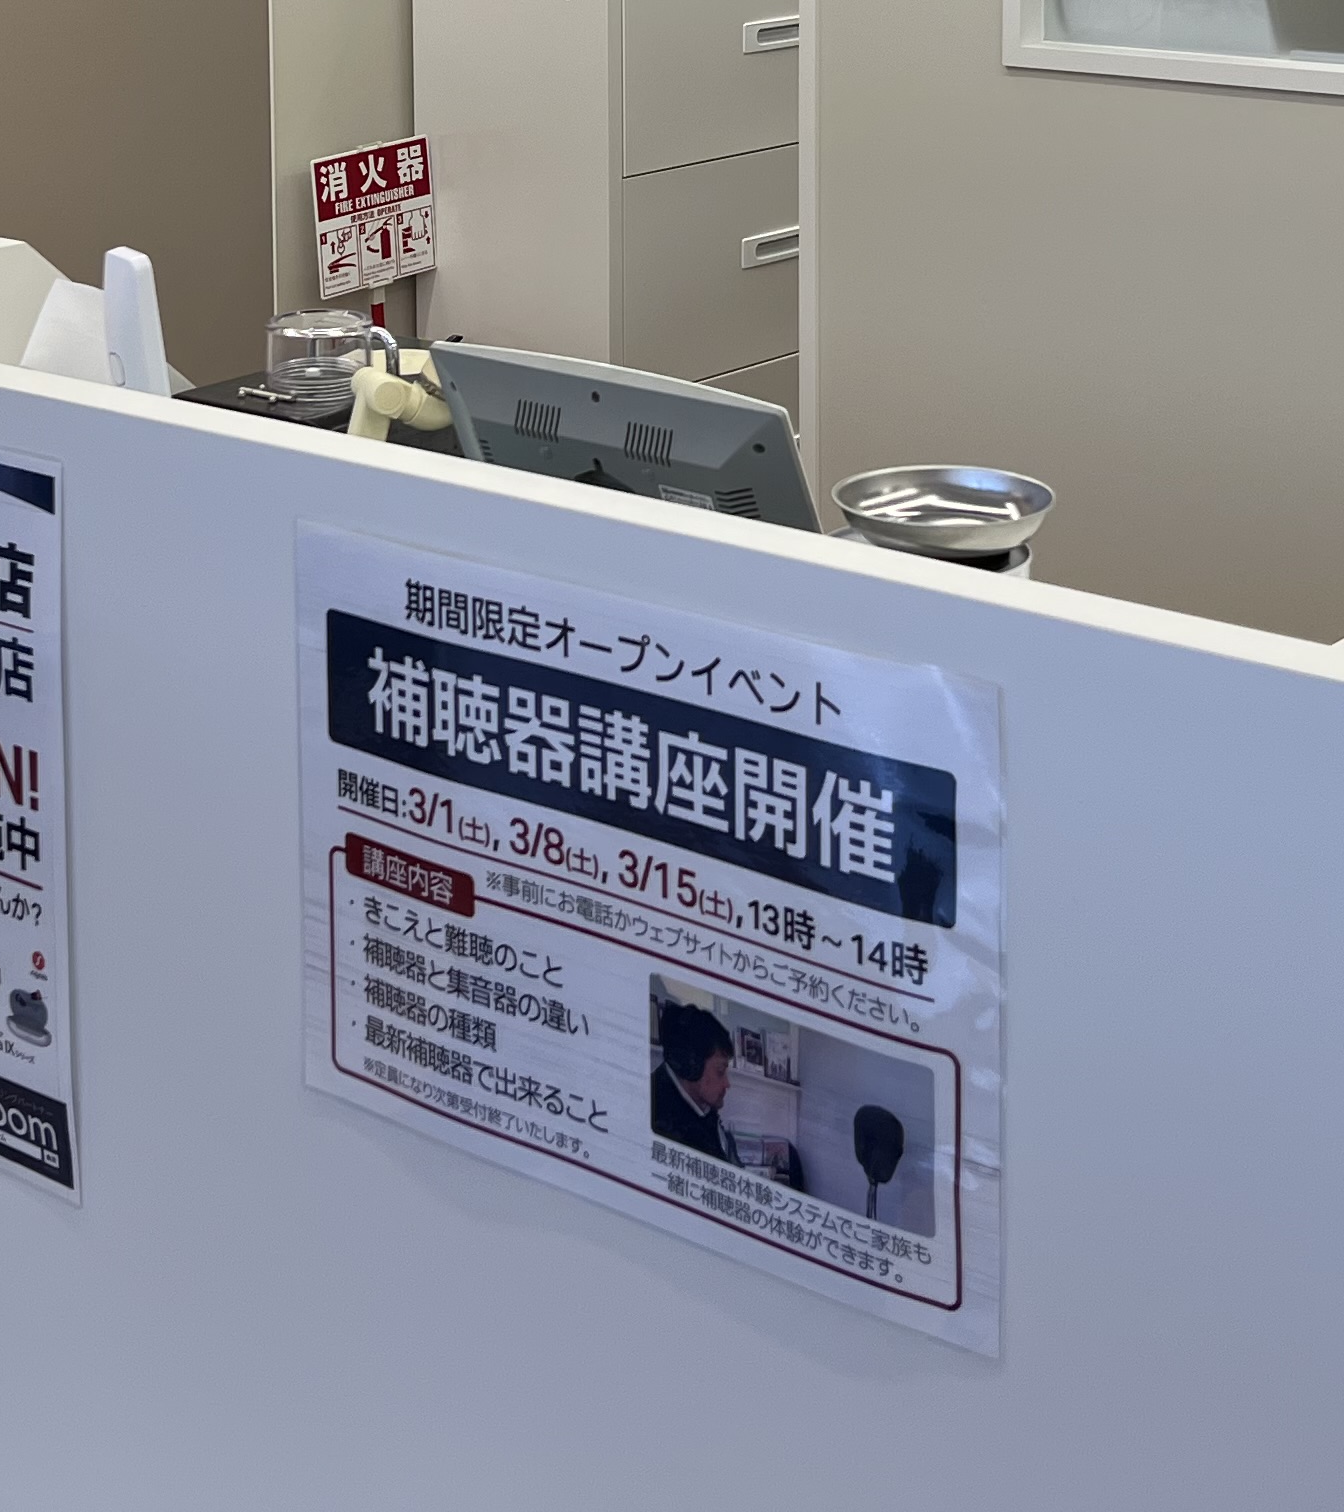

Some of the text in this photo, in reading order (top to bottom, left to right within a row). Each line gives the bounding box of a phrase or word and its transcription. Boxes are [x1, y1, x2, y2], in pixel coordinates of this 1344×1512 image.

[319, 144, 424, 204] 消火器
[335, 184, 415, 215] FIRE EXTINGUISHER
[377, 203, 401, 217] OPERATE
[403, 578, 842, 726] 期間限定オープンイベント
[366, 645, 897, 884] 補聴器講座開催
[362, 843, 454, 906] 講座内容
[362, 932, 591, 1037] 補聴器と集音器の違い
[363, 895, 564, 989] きこえと難聴のこと
[485, 869, 922, 1034] ※事前にお電話かウェブサイトからご予約ください。
[363, 973, 498, 1054] 補聴器の種類
[362, 1056, 591, 1160] ※定員になり次第受付終了いたします。
[364, 1014, 609, 1134] 最新補聴器で出来ること
[650, 1139, 932, 1266] 最新補聴器体験システムでご家族も
[650, 1170, 903, 1284] 一緒に補聴器の体験ができます。
